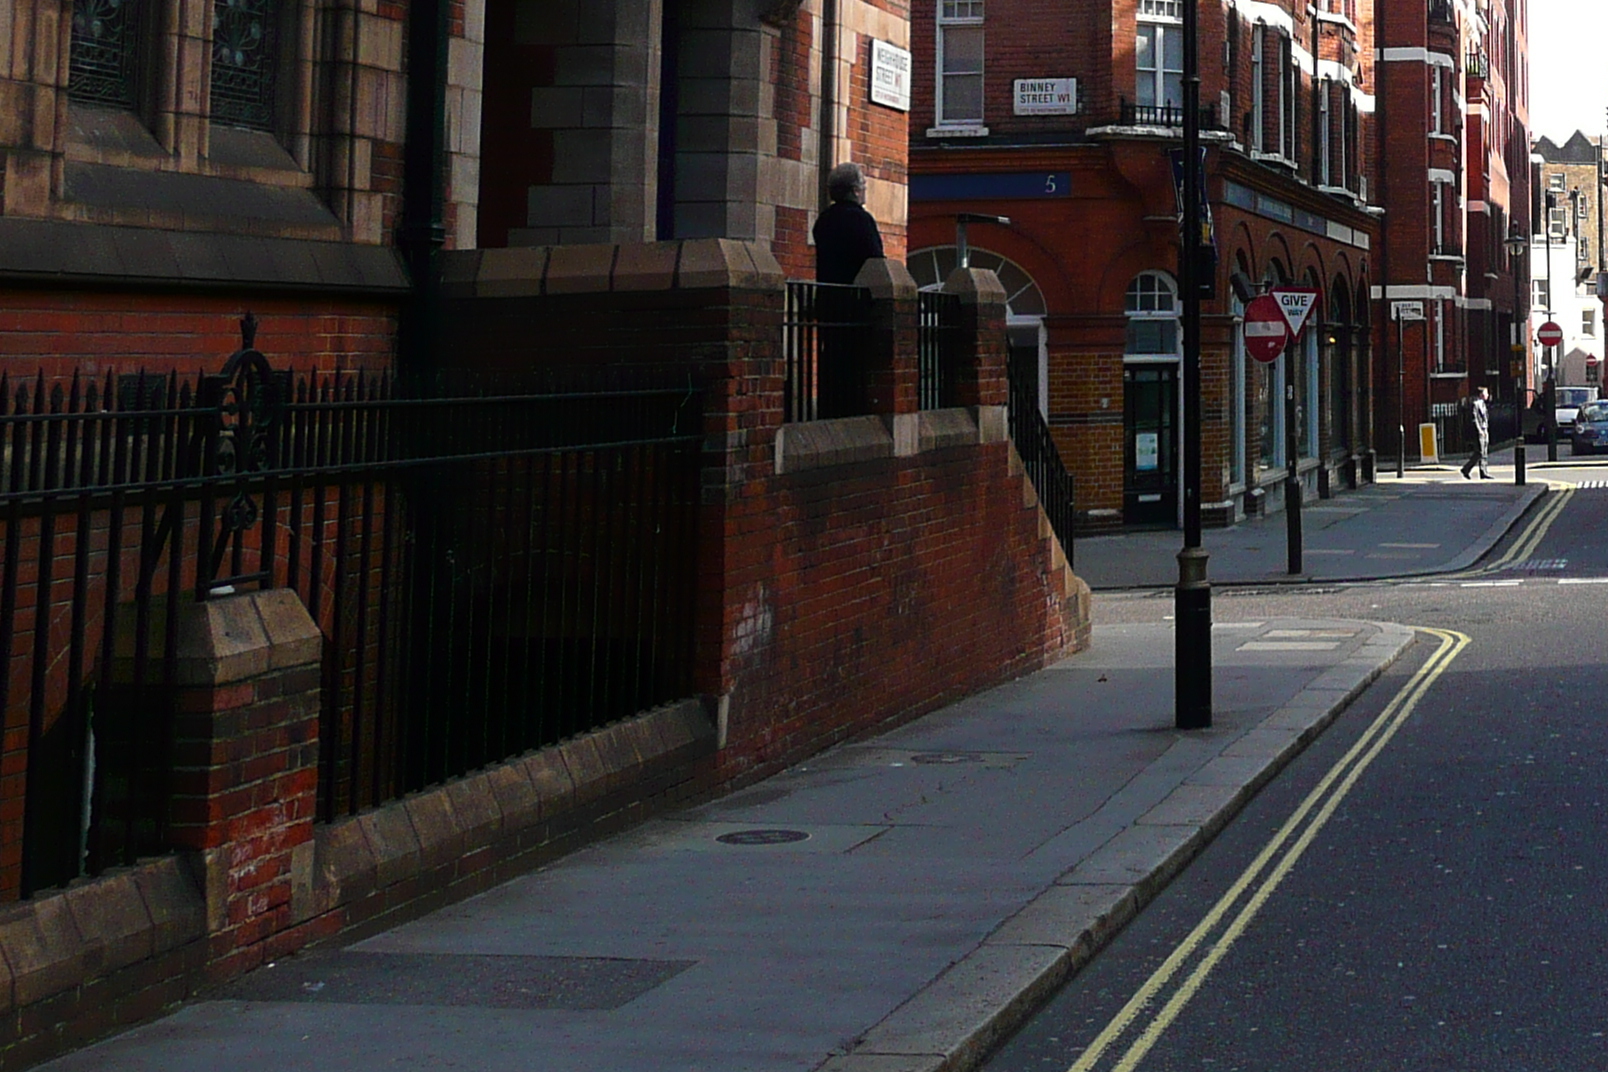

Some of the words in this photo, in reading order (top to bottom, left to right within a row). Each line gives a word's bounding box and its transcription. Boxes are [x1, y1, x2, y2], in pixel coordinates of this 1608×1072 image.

[1020, 82, 1056, 93] BINNEY
[1020, 93, 1053, 104] STREET
[1057, 93, 1071, 103] W1
[1045, 174, 1057, 194] 5
[1281, 294, 1308, 307] GIVE
[1287, 309, 1304, 317] WAY
